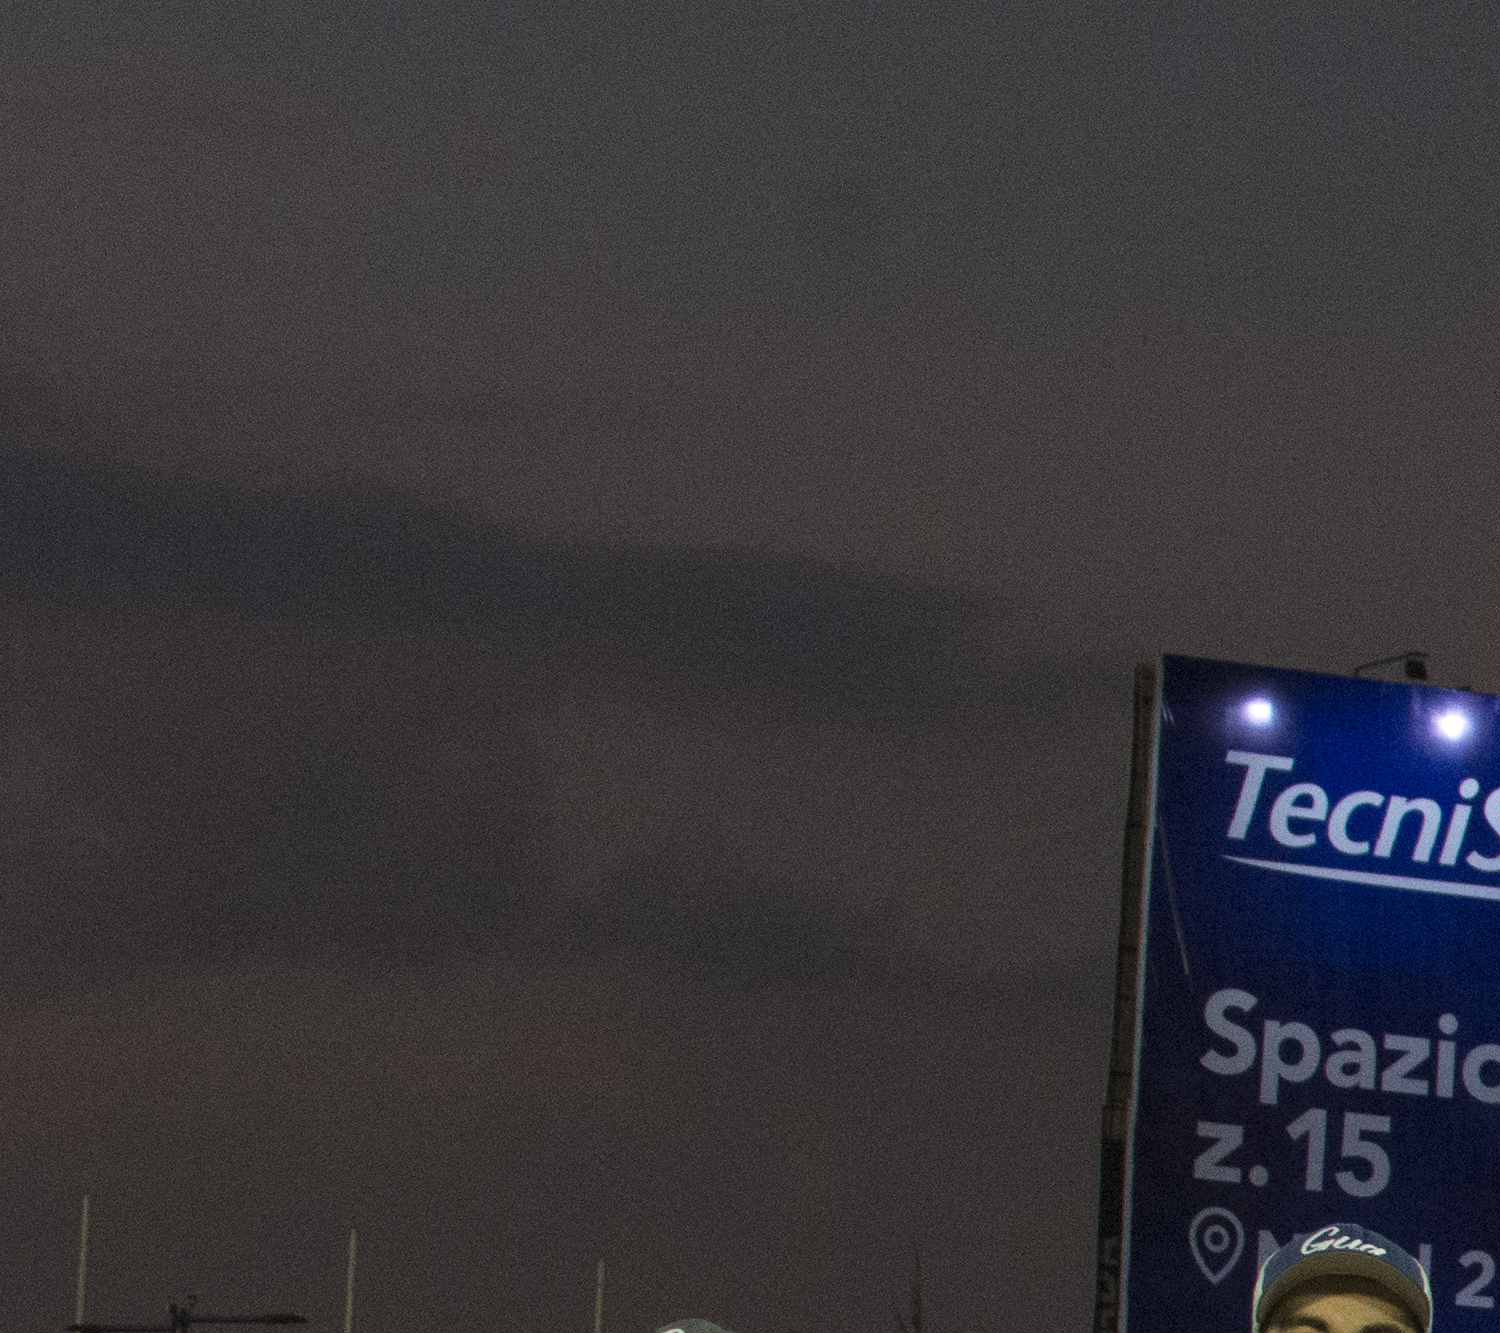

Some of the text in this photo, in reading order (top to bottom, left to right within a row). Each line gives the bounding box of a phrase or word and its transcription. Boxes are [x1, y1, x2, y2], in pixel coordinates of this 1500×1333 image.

[1193, 1108, 1392, 1198] z. 15
[1300, 1226, 1387, 1257] Gua
[1454, 1249, 1497, 1309] 2
